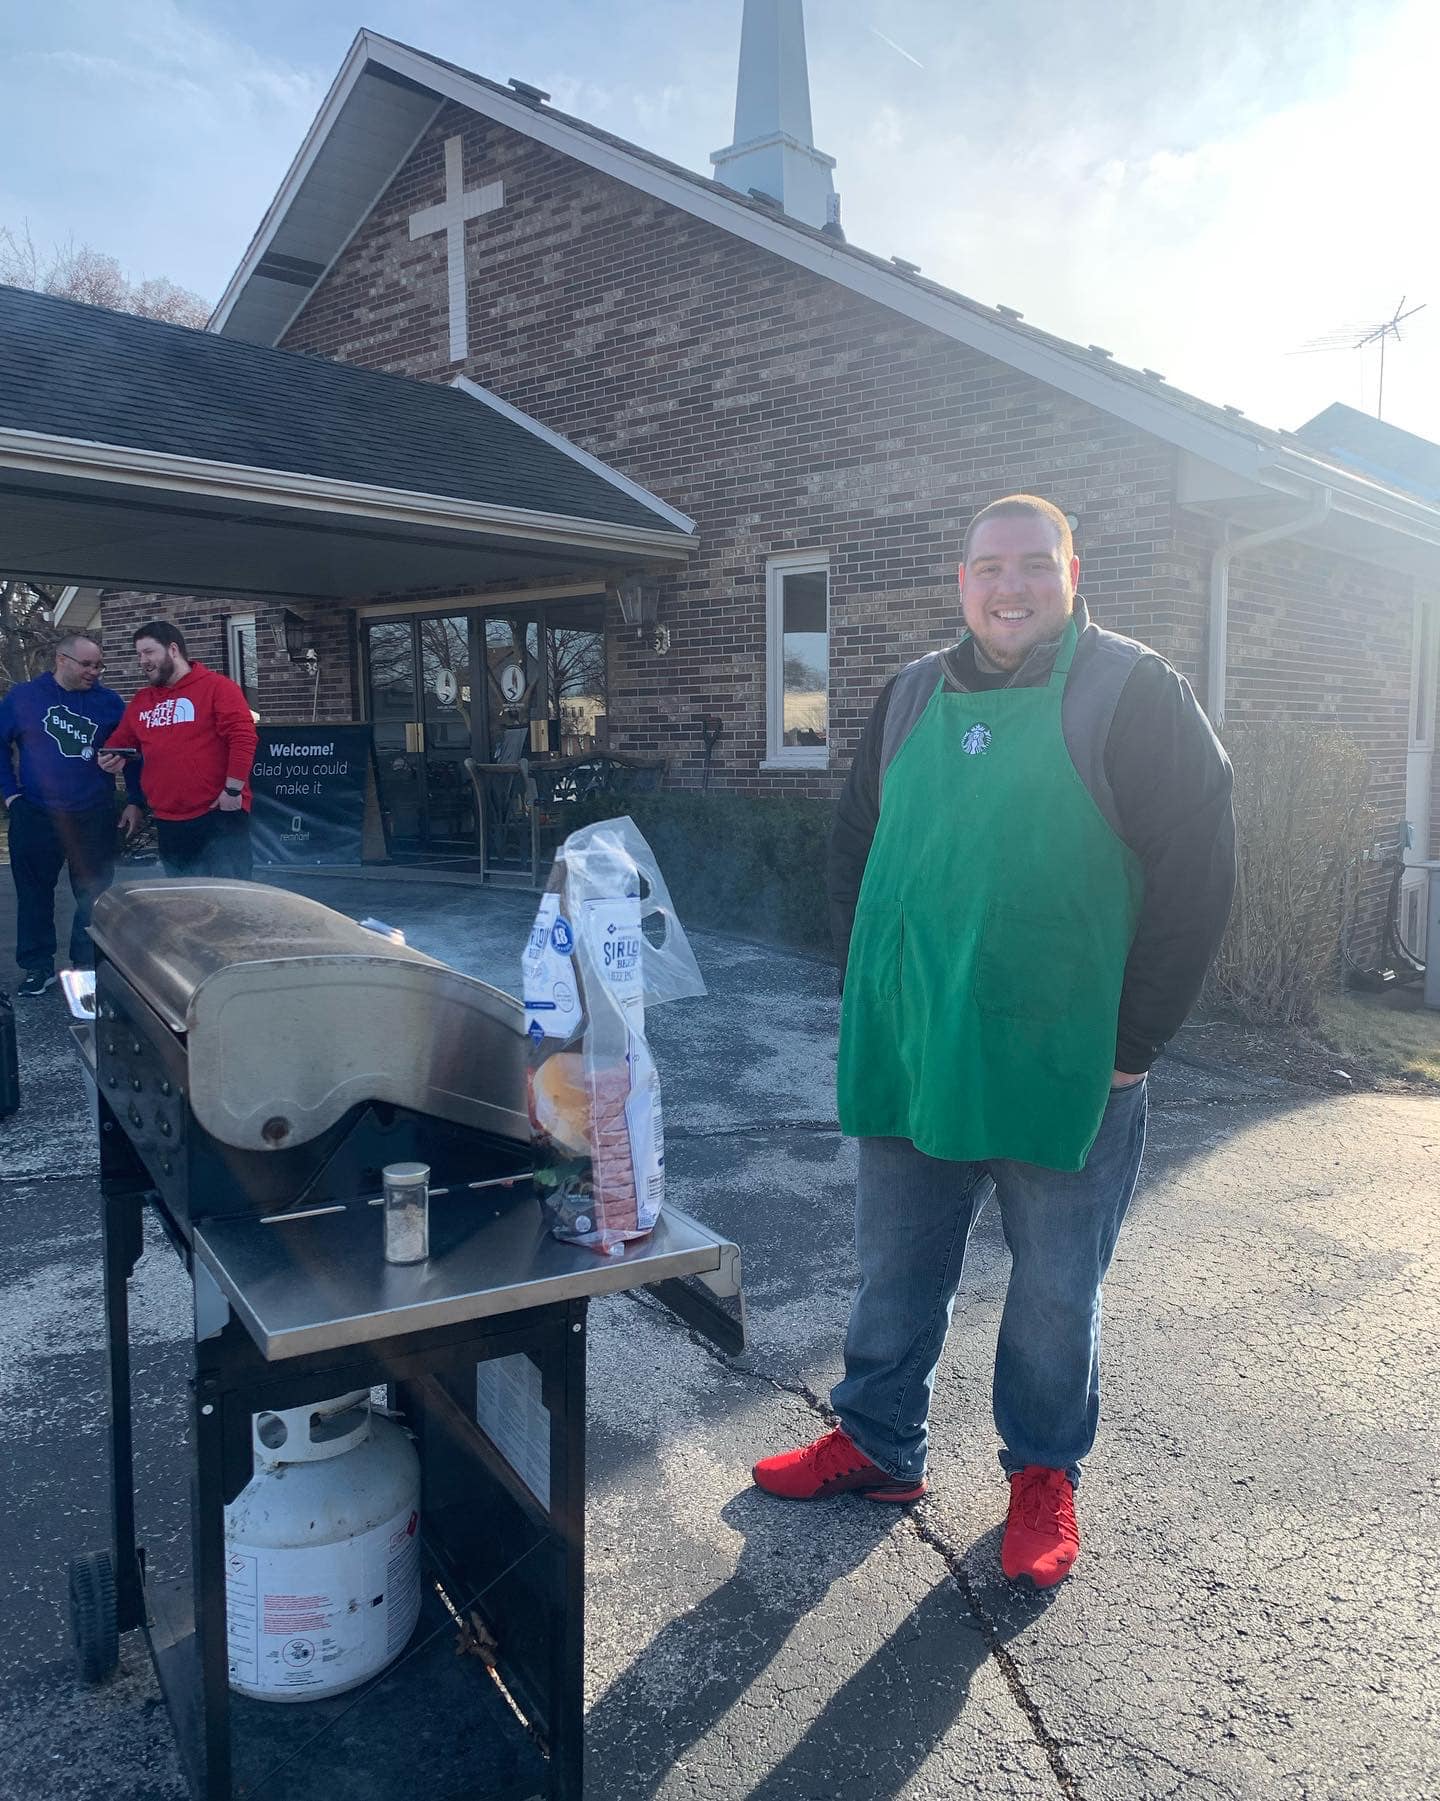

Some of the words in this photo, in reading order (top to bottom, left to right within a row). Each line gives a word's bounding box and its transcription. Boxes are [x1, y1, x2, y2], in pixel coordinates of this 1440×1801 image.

[139, 707, 174, 721] NORTH
[146, 716, 172, 728] FACE
[52, 715, 88, 744] BUCKS
[269, 743, 334, 757] Welcome!
[253, 762, 282, 777] Glad
[285, 764, 309, 779] you
[312, 761, 348, 776] could
[275, 781, 310, 795] make
[314, 781, 322, 794] it
